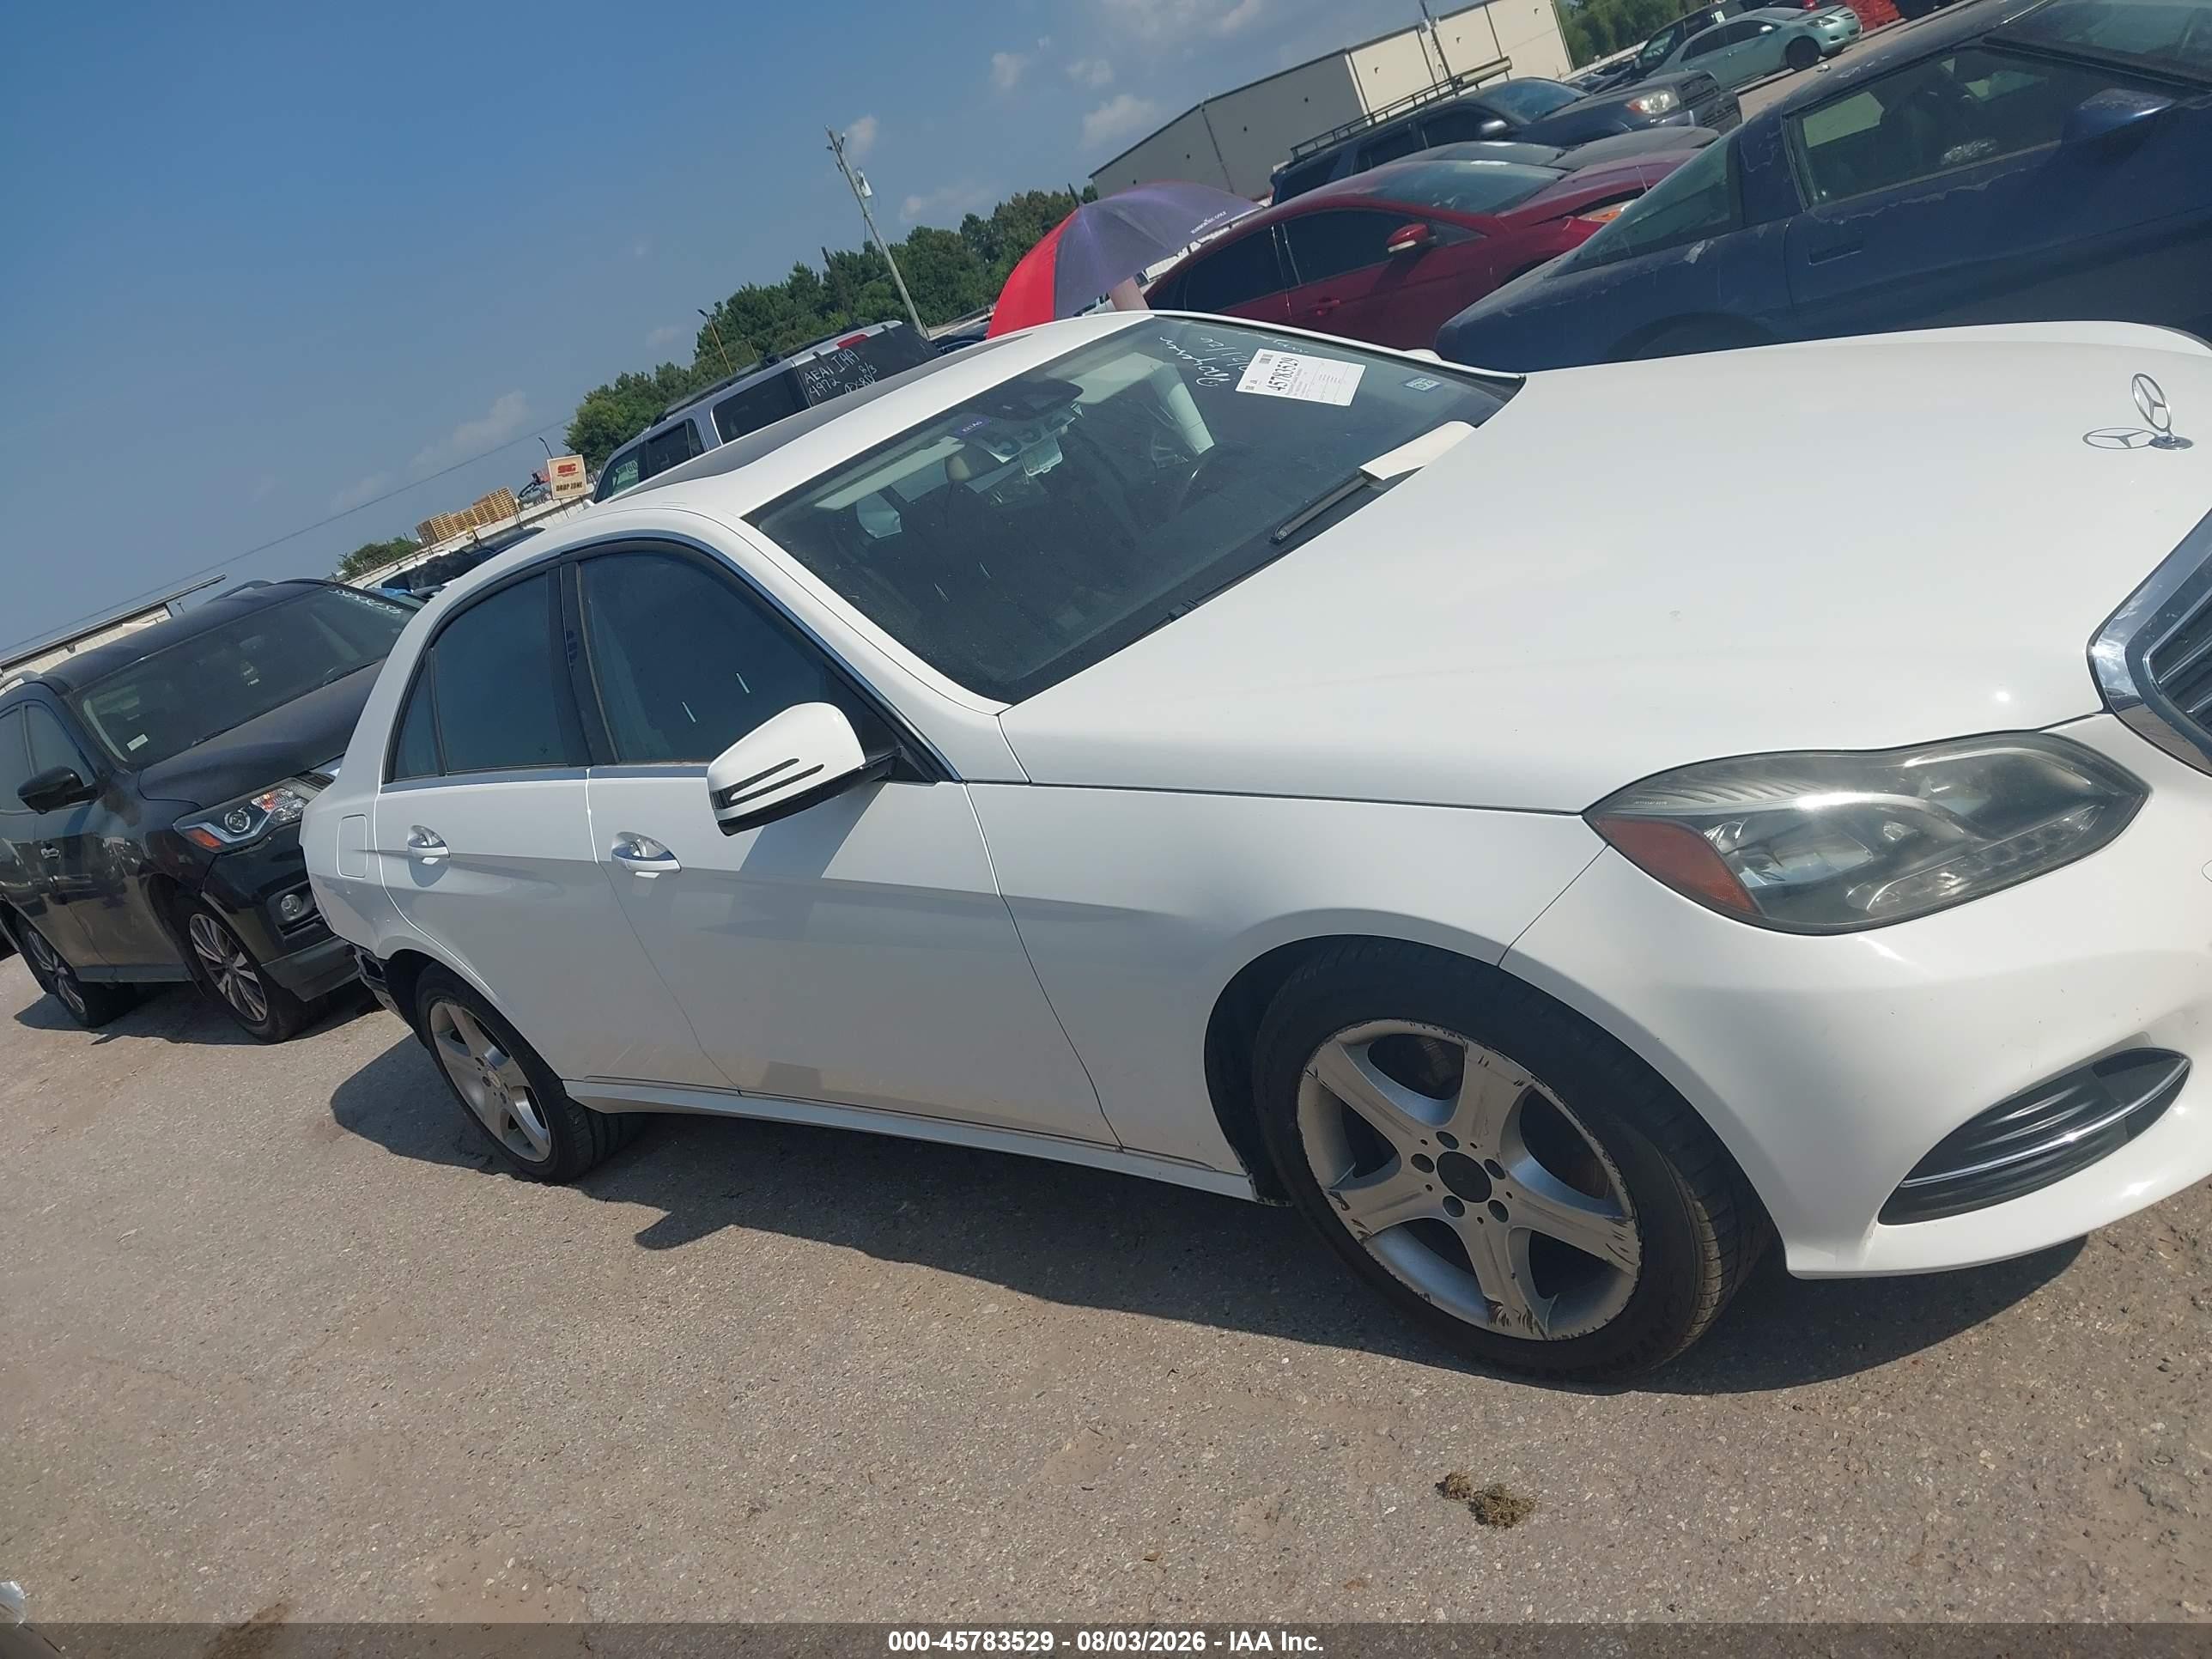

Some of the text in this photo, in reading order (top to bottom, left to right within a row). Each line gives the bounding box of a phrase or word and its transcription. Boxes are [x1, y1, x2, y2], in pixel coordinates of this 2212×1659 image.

[1266, 356, 1300, 392] 45783529
[809, 378, 842, 398] 4972
[570, 481, 582, 489] ZONE
